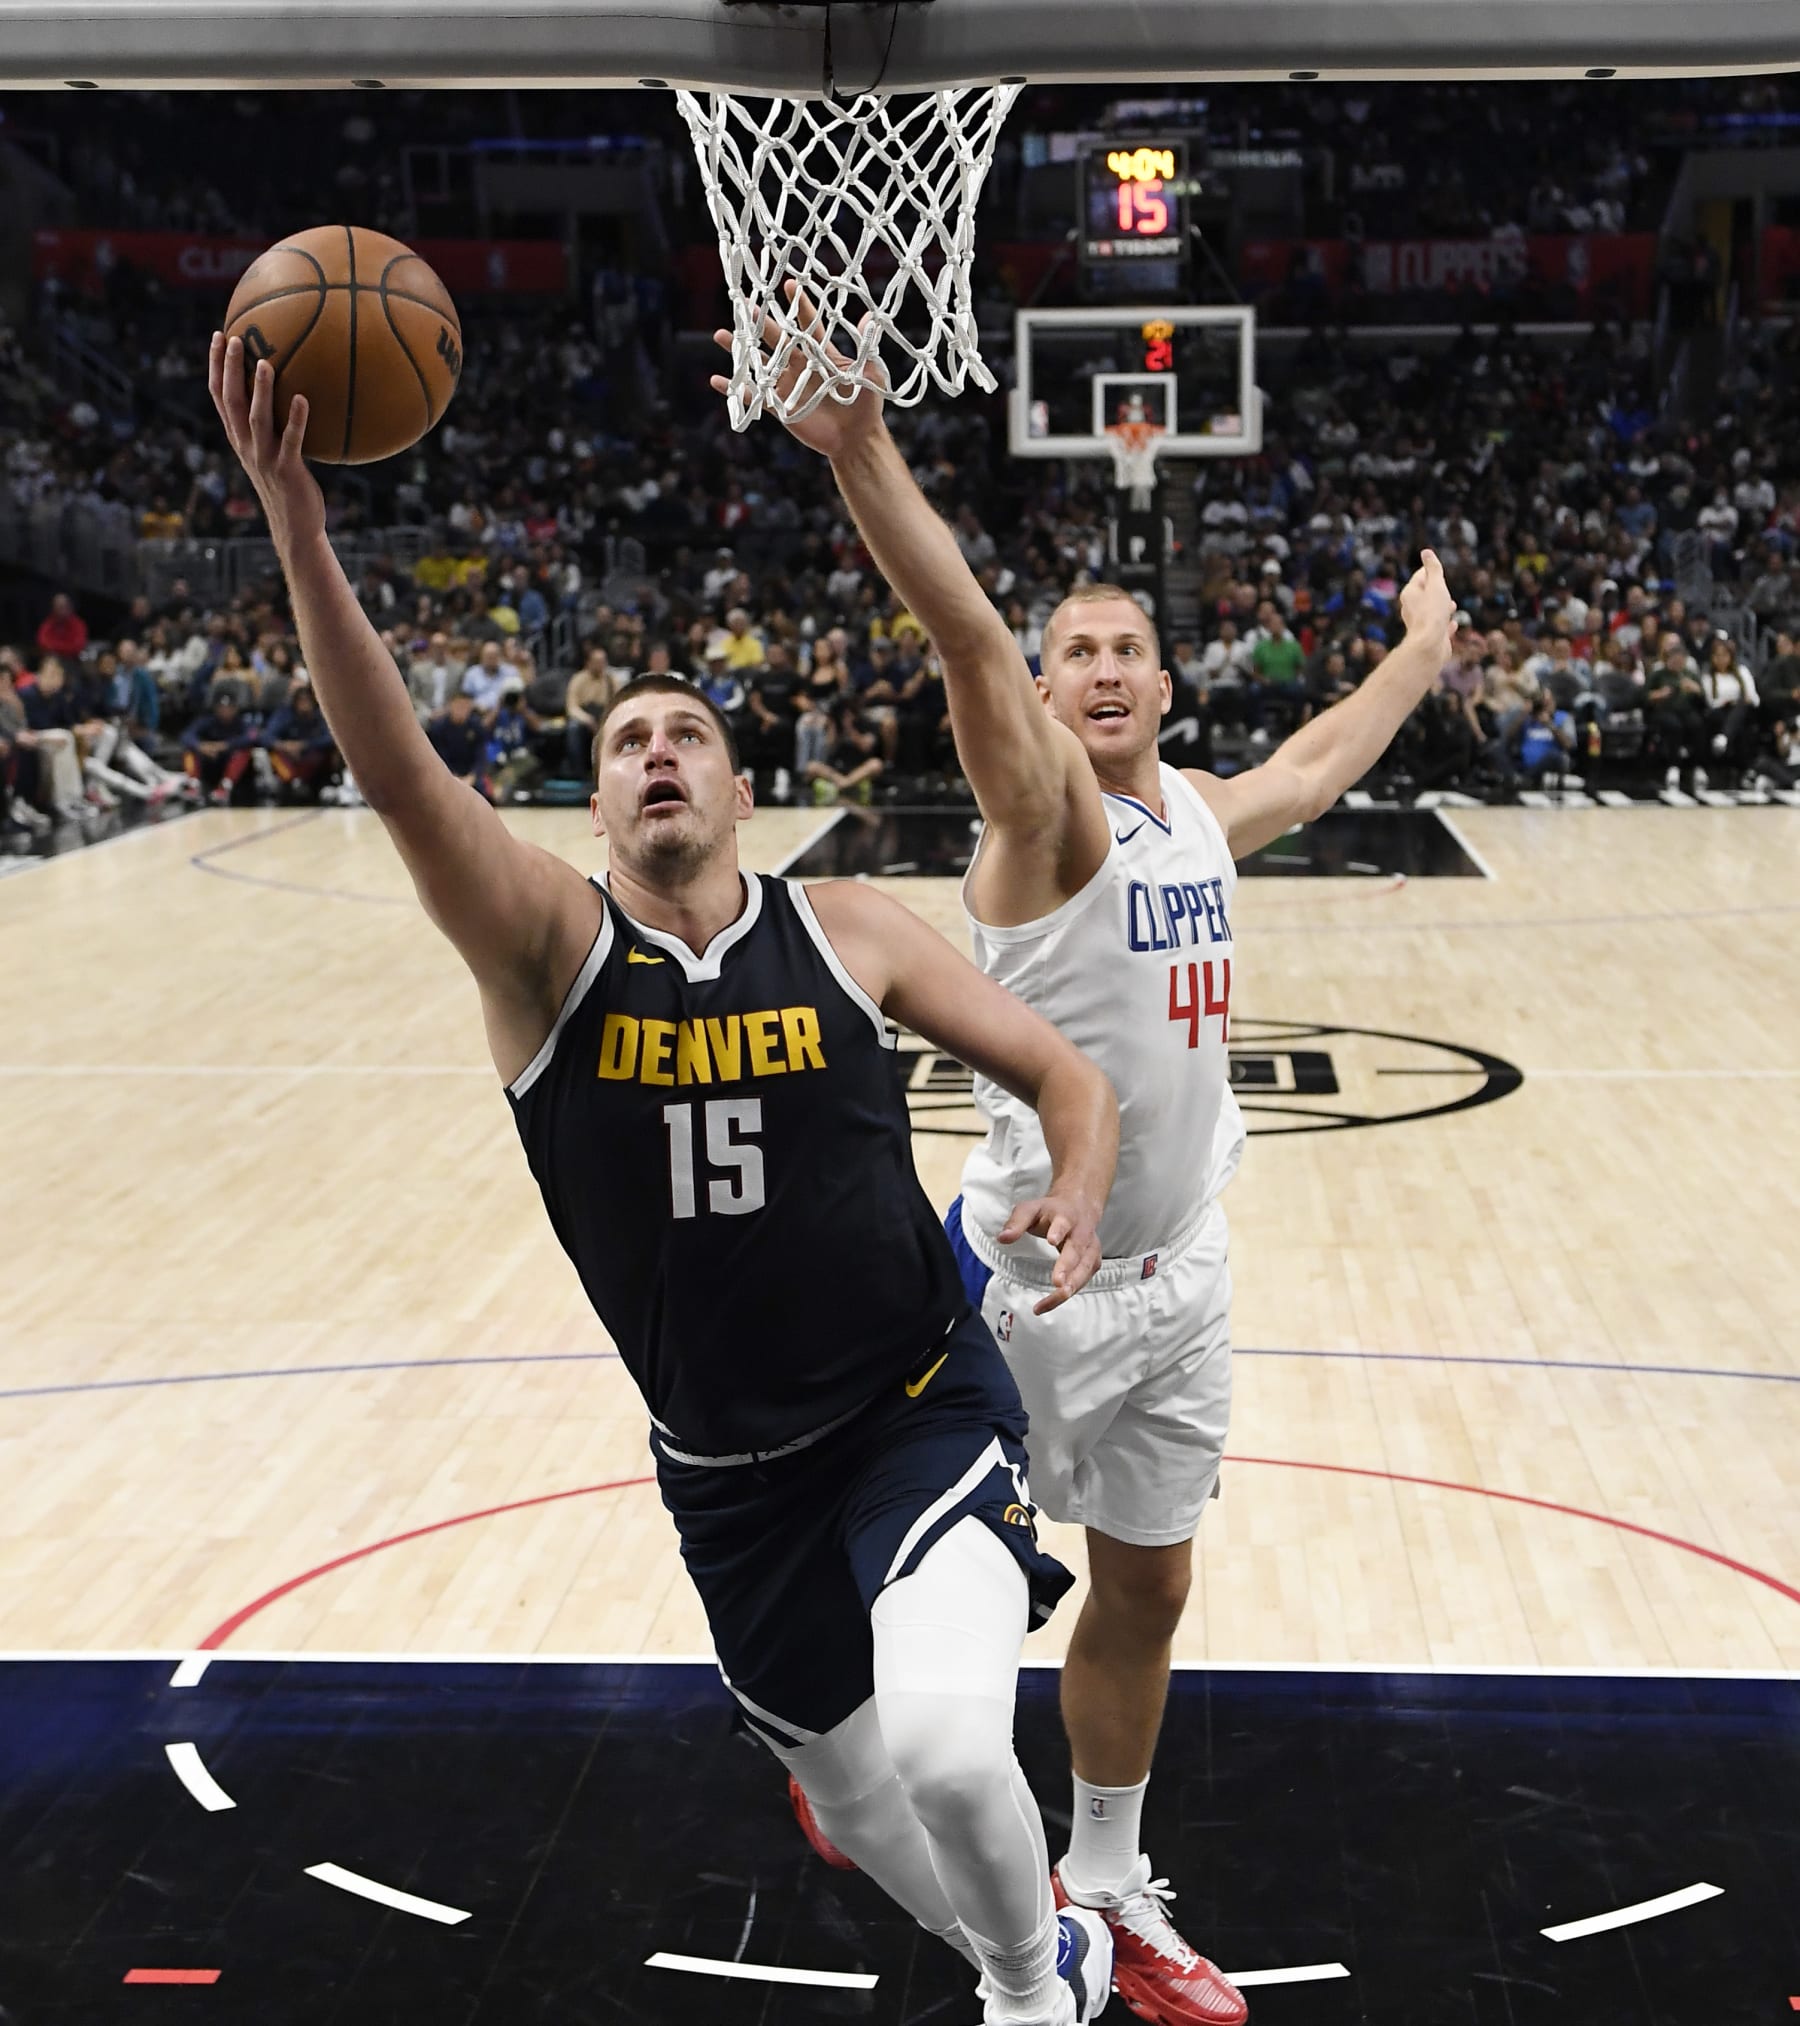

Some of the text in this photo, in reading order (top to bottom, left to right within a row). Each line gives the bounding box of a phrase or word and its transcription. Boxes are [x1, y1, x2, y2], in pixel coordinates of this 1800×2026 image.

[1117, 178, 1168, 234] 15
[597, 1006, 828, 1087] DENVER
[1169, 958, 1231, 1049] 44
[663, 1097, 766, 1219] 15
